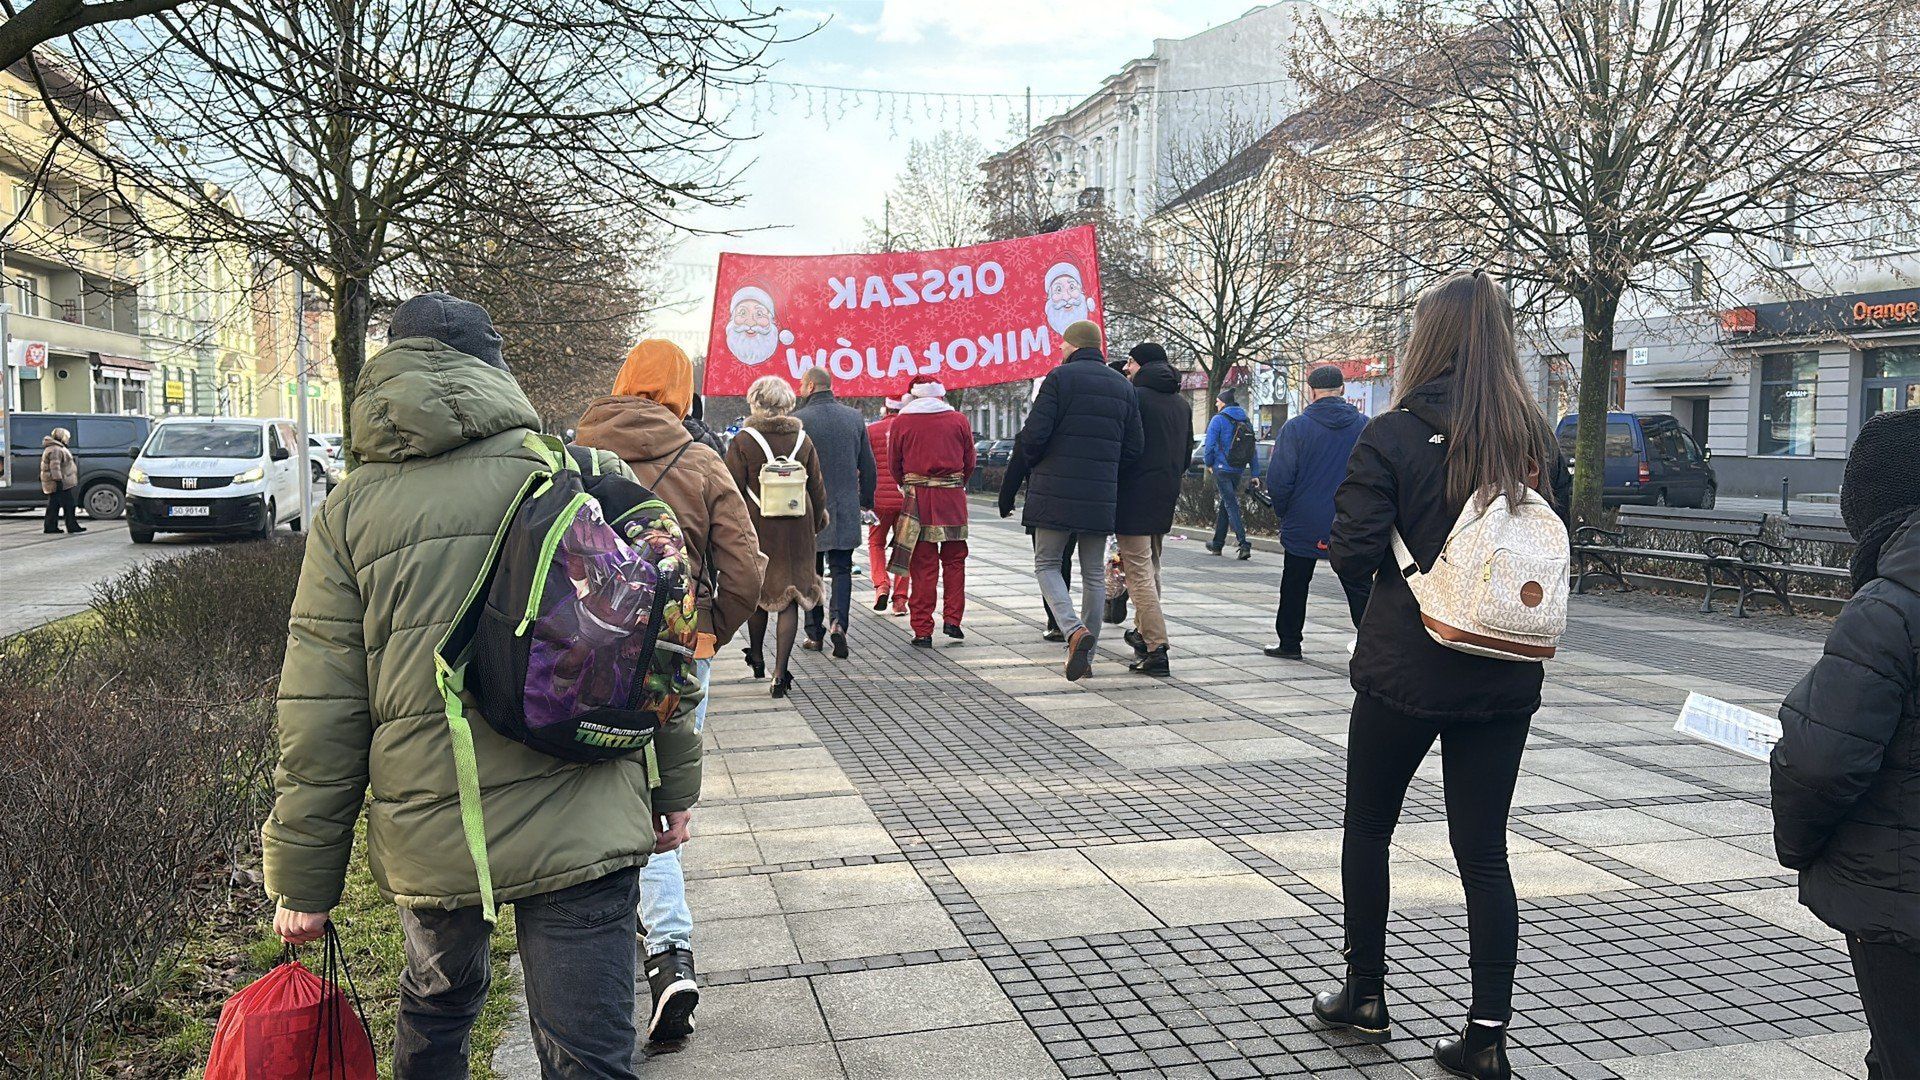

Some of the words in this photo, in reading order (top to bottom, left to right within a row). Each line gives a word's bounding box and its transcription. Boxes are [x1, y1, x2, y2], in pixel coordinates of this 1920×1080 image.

[1853, 301, 1919, 322] Orange
[1428, 434, 1445, 444] 4F
[181, 477, 198, 489] FIAT
[579, 721, 611, 733] TEENAGE
[610, 727, 639, 736] MUTANT
